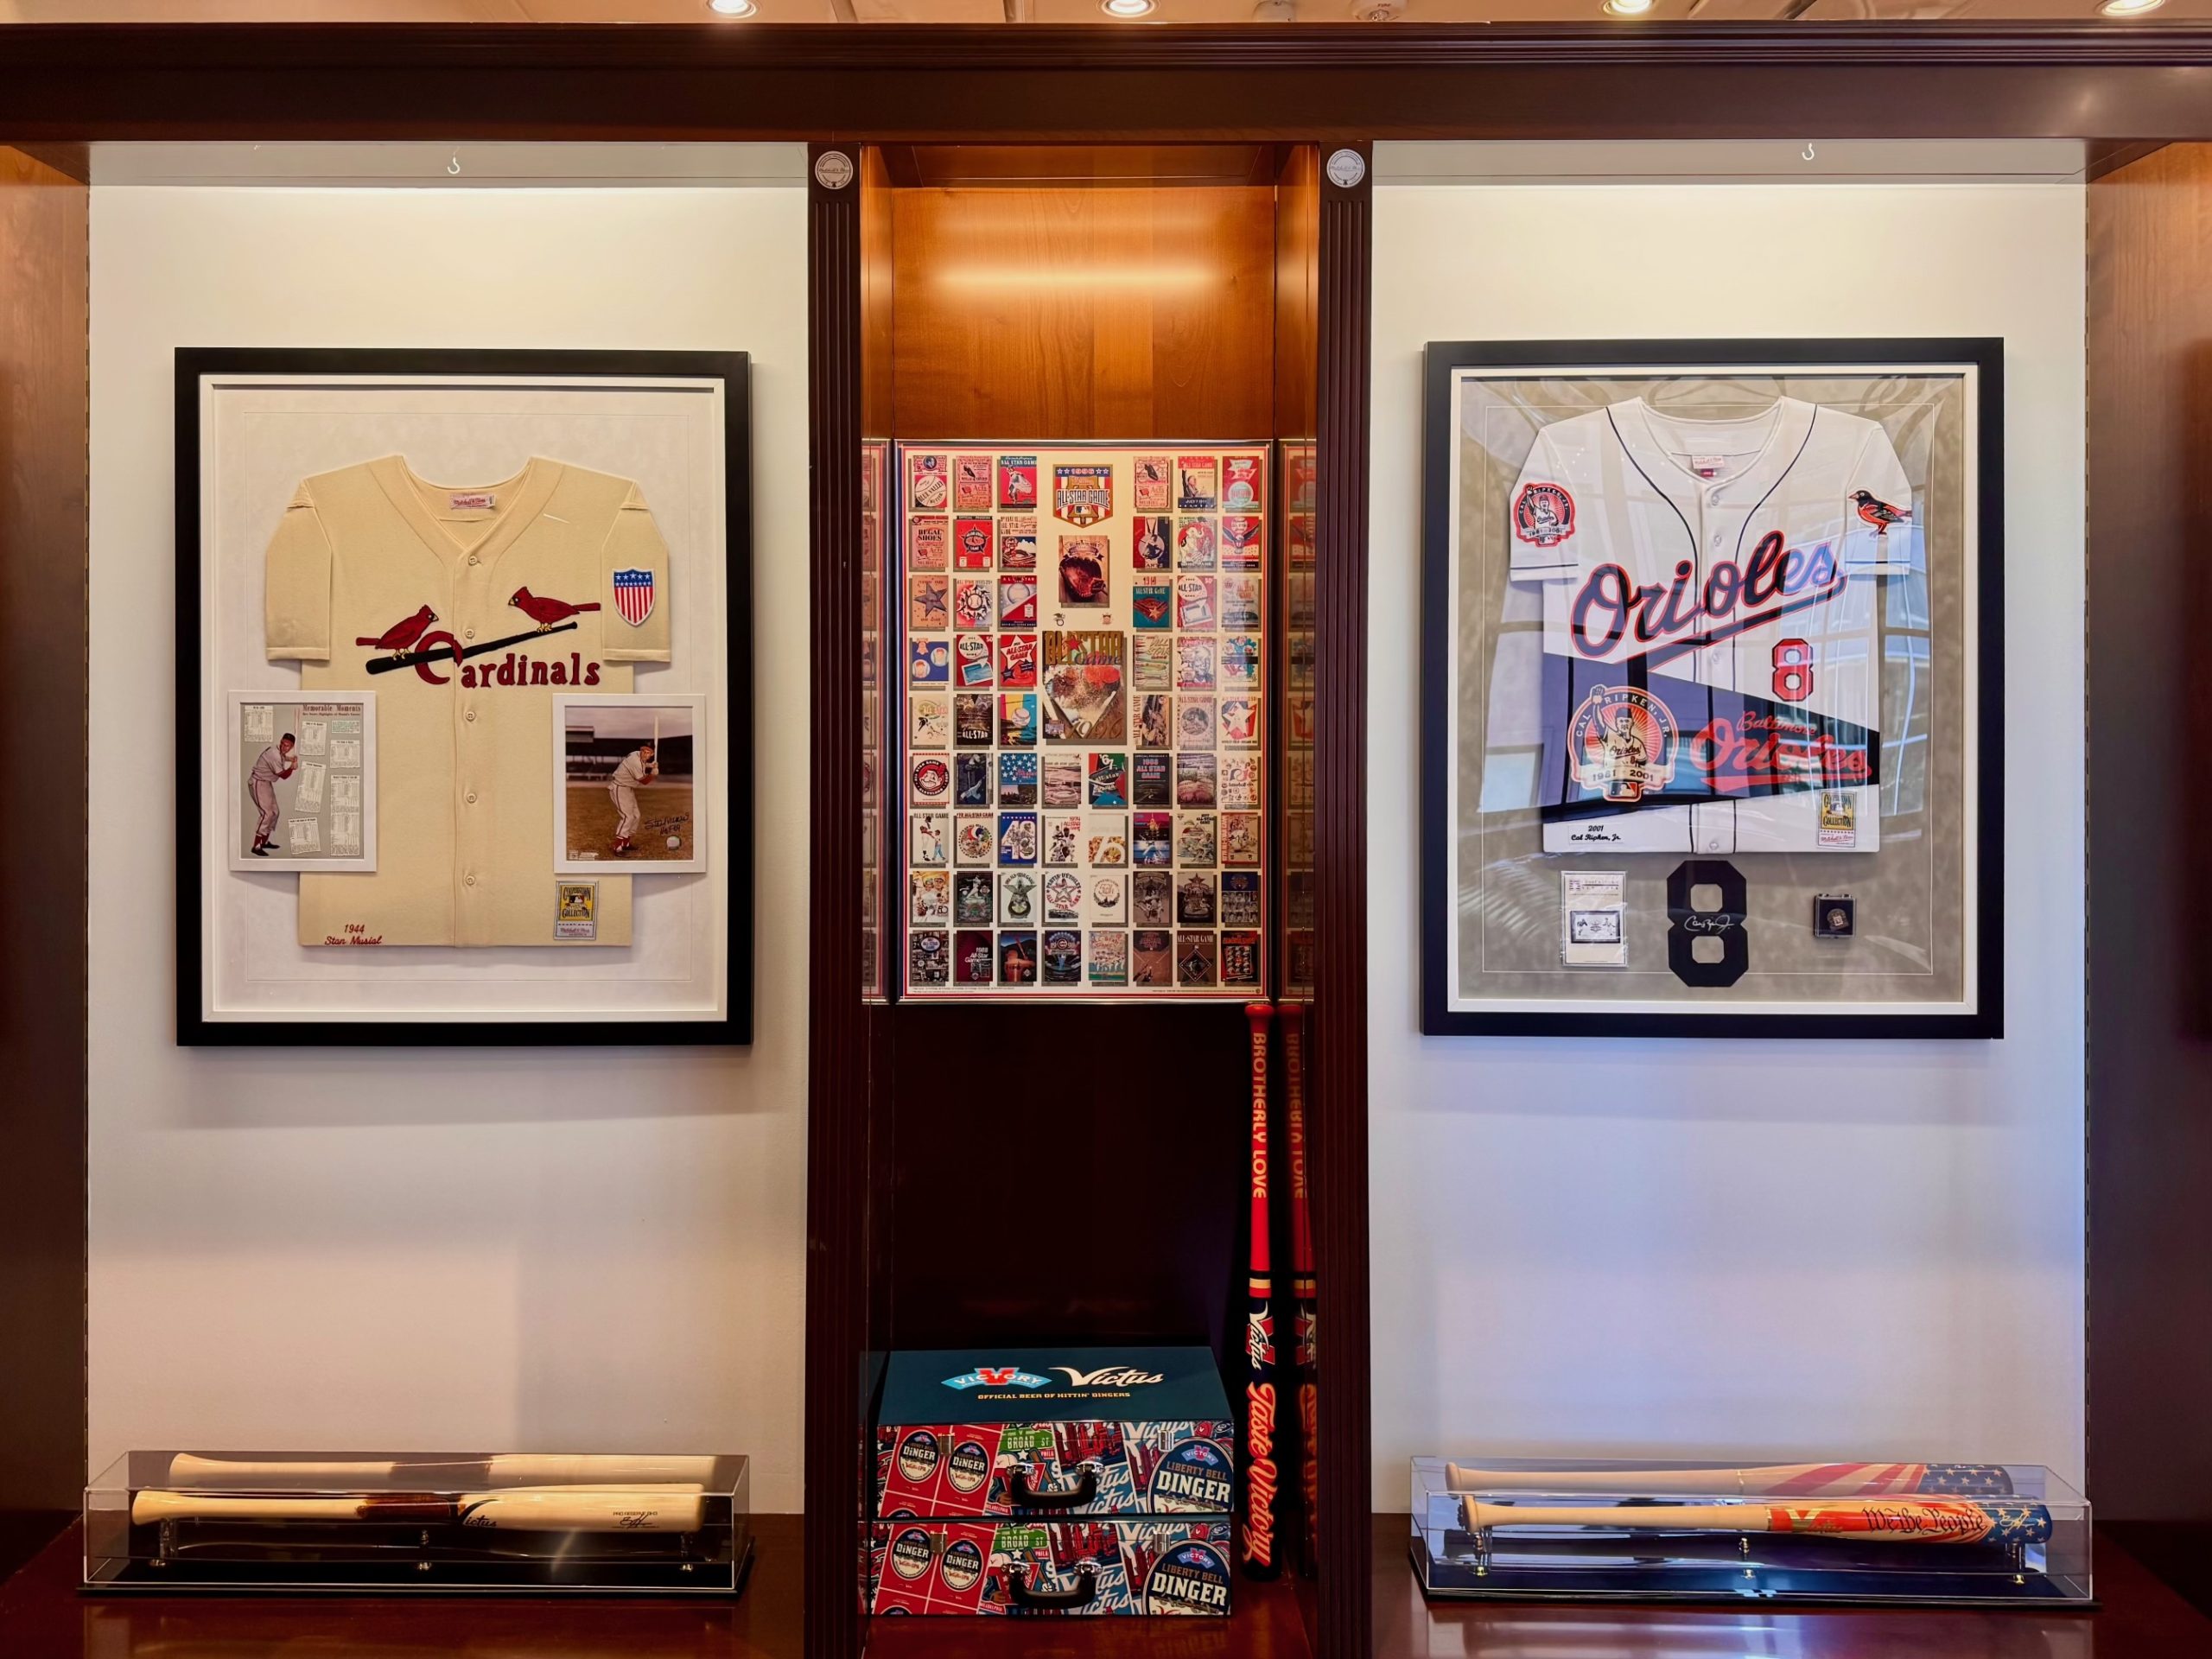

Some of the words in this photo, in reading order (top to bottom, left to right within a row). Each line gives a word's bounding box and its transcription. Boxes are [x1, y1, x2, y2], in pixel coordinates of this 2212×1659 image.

[1089, 489, 1109, 509] GAME
[1571, 530, 1841, 659] Orioles
[414, 630, 601, 689] Cardinals
[960, 642, 984, 652] ALL-STAR
[1772, 638, 1814, 702] 8
[1576, 714, 1591, 737] CAL
[1605, 694, 1657, 715] RIPKEN,
[1659, 718, 1670, 737] JR.
[1737, 710, 1817, 735] Baltimore
[1690, 718, 1869, 772] Orioles
[1630, 770, 1654, 782] 2001
[1585, 834, 1611, 842] Ripken,
[344, 924, 365, 933] 1944
[1667, 860, 1749, 987] 8
[325, 935, 346, 945] Stan
[350, 935, 382, 945] Musial
[1253, 1033, 1268, 1143] BROTHERLY
[1253, 1150, 1268, 1199] LOVE
[1249, 1300, 1269, 1371] Victus
[952, 1373, 1044, 1386] VICTORY
[1048, 1366, 1166, 1388] Victus
[1247, 1381, 1276, 1459] Taste
[1007, 1435, 1035, 1449] BROAD
[1040, 1437, 1050, 1446] ST
[1186, 1451, 1215, 1462] VICTORY
[1166, 1461, 1204, 1476] LIBERTY
[1205, 1469, 1227, 1481] BELL
[1156, 1470, 1230, 1503] DINGER
[1241, 1458, 1278, 1567] Victory
[1922, 1507, 1985, 1535] People
[1001, 1535, 1029, 1548] BROAD
[1035, 1537, 1044, 1546] ST
[1182, 1552, 1211, 1564] VICTORY
[1161, 1562, 1199, 1579] LIBERTY
[1202, 1571, 1224, 1584] BELL
[1152, 1572, 1227, 1606] DINGER
